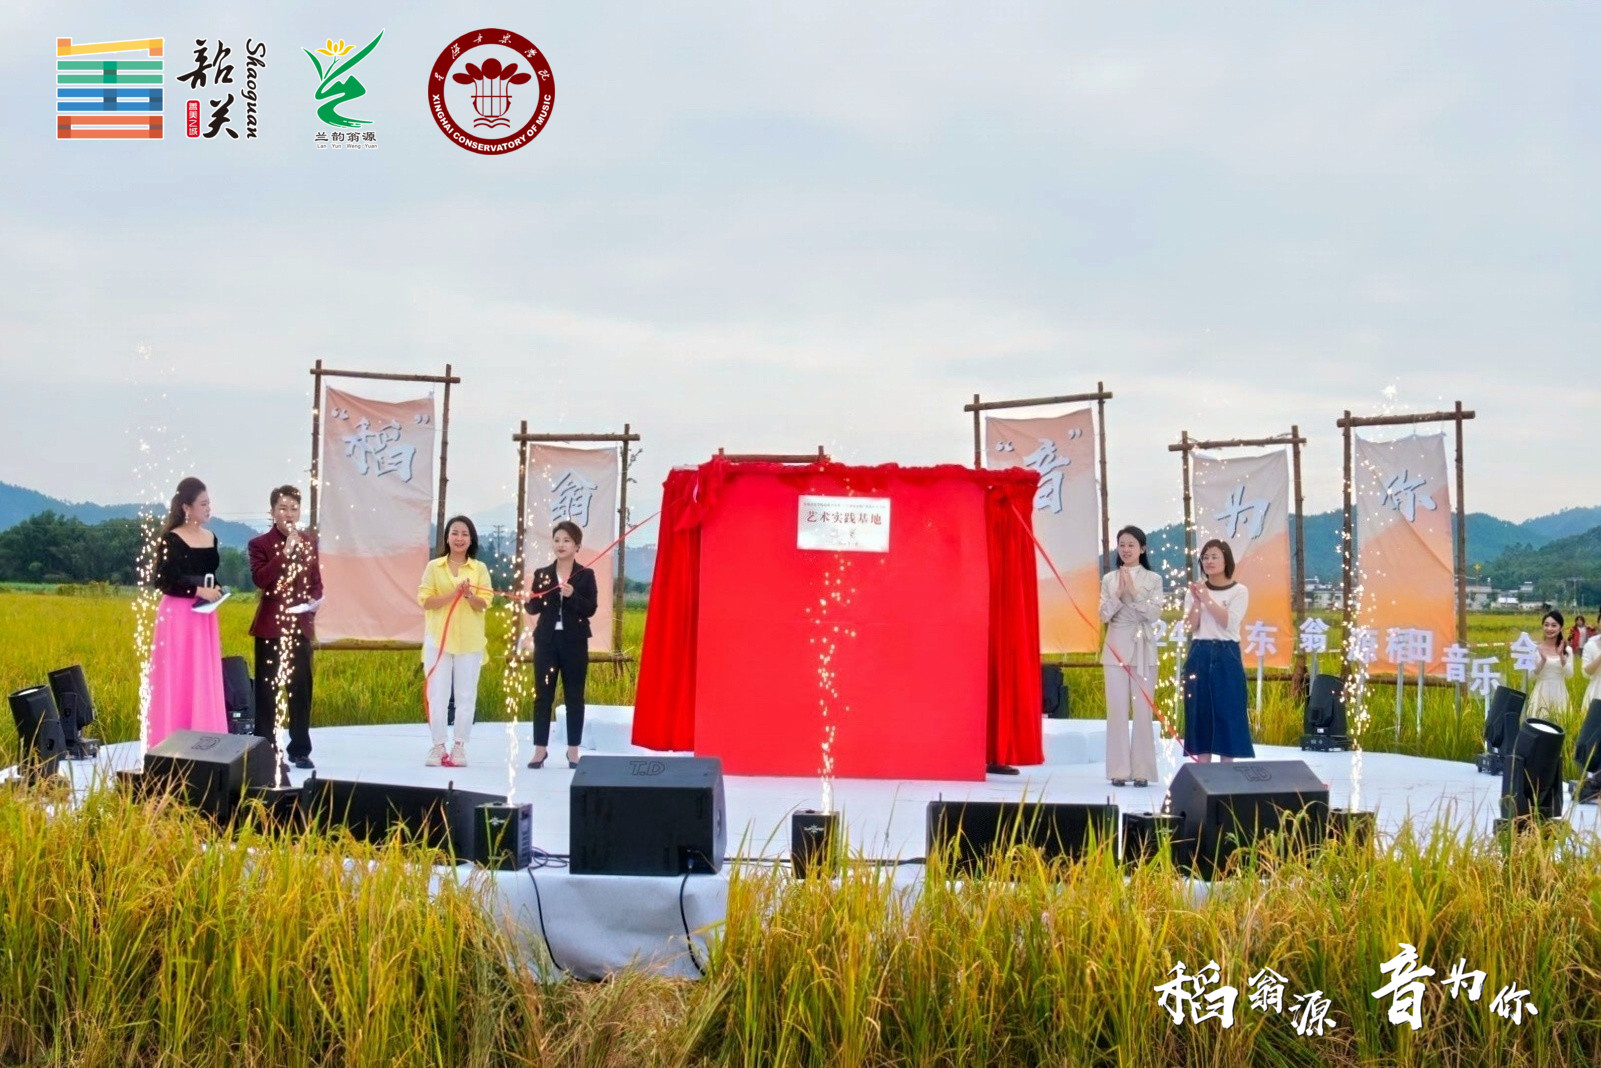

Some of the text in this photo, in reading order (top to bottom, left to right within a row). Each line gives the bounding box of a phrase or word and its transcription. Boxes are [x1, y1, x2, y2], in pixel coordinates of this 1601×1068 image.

[551, 467, 598, 528] 翁
[806, 510, 882, 526] 艺术实践基地
[1214, 485, 1271, 540] 为
[1381, 468, 1438, 524] 你
